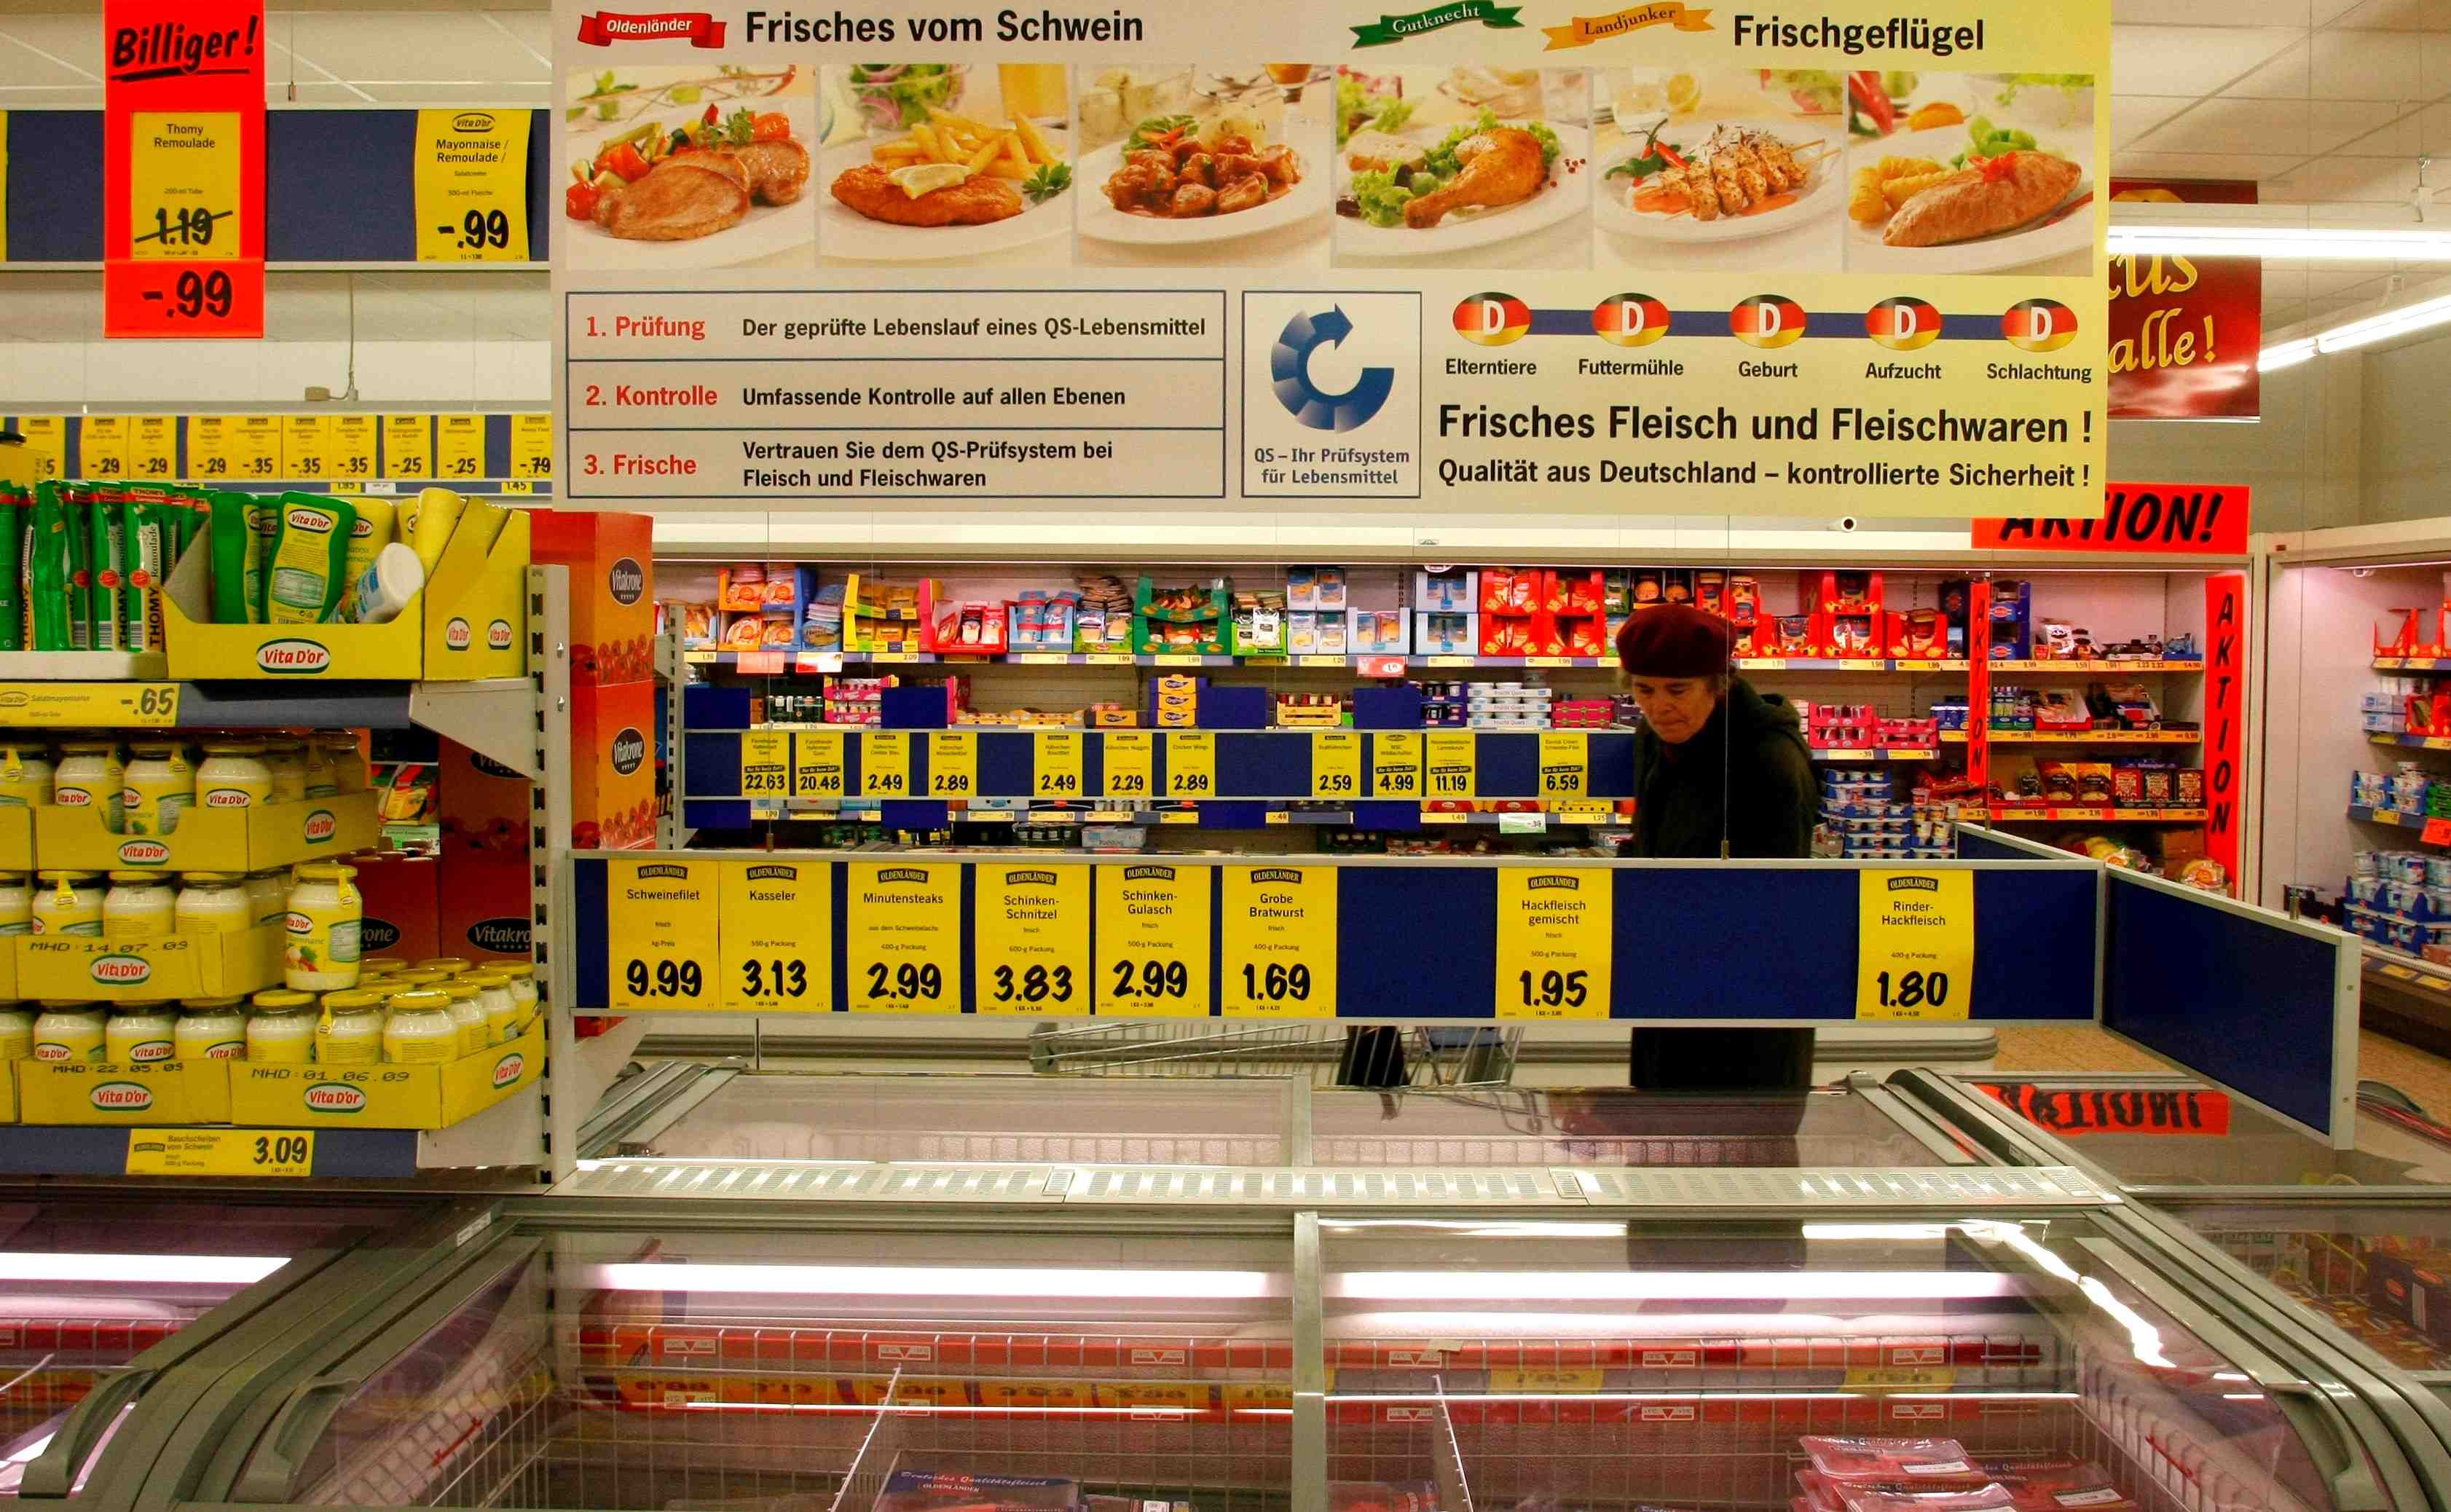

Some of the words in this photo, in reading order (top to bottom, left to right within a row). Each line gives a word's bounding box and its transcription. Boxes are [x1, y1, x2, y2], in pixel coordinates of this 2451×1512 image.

[606, 17, 693, 35] Oldenländer
[745, 12, 894, 43] Frisches
[908, 18, 983, 42] vom
[996, 10, 1144, 42] Schwein
[1392, 5, 1481, 36] Gutknecht
[1584, 7, 1677, 39] Landjunker
[1734, 15, 1986, 58] Frischgeflügel
[167, 123, 204, 135] Thomy
[154, 137, 216, 148] Remoulade
[436, 140, 501, 151] Mayonnaise
[437, 153, 498, 162] Remoulade
[156, 208, 213, 245] 1.19
[438, 210, 509, 249] -.99
[144, 269, 233, 318] -.99
[1482, 299, 1506, 335] D
[1622, 301, 1645, 336] D
[1759, 302, 1781, 337] D
[1895, 305, 1917, 339] D
[2030, 307, 2053, 341] D
[586, 316, 607, 337] 1.
[615, 315, 705, 340] Prüfung
[743, 319, 777, 336] Der
[784, 318, 866, 339] geprüfte
[874, 319, 979, 337] Lebenslauf
[986, 319, 1037, 336] eines
[1044, 318, 1205, 338] QS-Lebensmittel
[1445, 358, 1537, 375] Elterntiere
[1578, 358, 1684, 376] Futtermühle
[1738, 361, 1798, 378] Geburt
[1865, 362, 1941, 380] Aufzucht
[1987, 363, 2092, 384] Schlachtung
[586, 385, 607, 406] 2.
[615, 385, 717, 406] Kontrolle
[743, 387, 861, 406] Umfassende
[868, 387, 955, 406] Kontrolle
[961, 387, 994, 405] auf
[1000, 387, 1046, 405] allen
[1053, 388, 1125, 406] Ebenen
[1439, 403, 1595, 438] Frisches
[1609, 405, 1737, 440] Fleisch
[1752, 407, 1817, 440] und
[1832, 408, 2068, 444] Fleischwaren
[743, 441, 838, 460] Vertrauen
[846, 441, 875, 459] Sie
[882, 441, 924, 459] dem
[932, 441, 1077, 462] QS-Prüfsystem
[1083, 441, 1112, 459] bei
[1254, 449, 1275, 465] QS
[1291, 449, 1315, 463] Ihr
[1321, 448, 1409, 466] Prüfsystem
[583, 454, 605, 475] 3.
[613, 454, 696, 475] Frische
[1439, 458, 1538, 487] Qualität
[1546, 464, 1591, 484] aus
[1600, 460, 1756, 484] Deutschland
[1787, 462, 1940, 486] kontrollierte
[1949, 462, 2075, 487] Sicherheit
[743, 468, 811, 487] Fleisch
[818, 468, 852, 487] und
[859, 468, 986, 488] Fleischwaren
[1262, 469, 1286, 484] für
[1292, 469, 1397, 484] Lebensmittel
[292, 514, 310, 525] Vita
[119, 588, 127, 646] THOMY
[149, 588, 160, 647] THOMY
[264, 650, 293, 664] Vita
[296, 650, 323, 664] D'or
[121, 688, 175, 716] -.65
[613, 739, 643, 763] Vitakrone
[745, 775, 784, 790] 22.63
[800, 776, 840, 790] 20.48
[869, 775, 902, 790] 2.49
[935, 775, 968, 790] 2.89
[1041, 774, 1076, 790] 2.49
[1112, 775, 1144, 790] 2.29
[1174, 774, 1208, 790] 2.89
[1319, 775, 1352, 791] 2.59
[1380, 775, 1414, 791] 4.99
[1436, 775, 1466, 791] 11.19
[1546, 774, 1579, 790] 6.59
[123, 848, 144, 857] Vita
[627, 889, 699, 900] Schweinefilet
[750, 891, 795, 900] Kasseler
[863, 893, 943, 904] Minutensteaks
[1004, 896, 1059, 905] Schinken-
[1122, 891, 1177, 900] Schinken-
[1260, 894, 1293, 904] Grobe
[1007, 909, 1057, 919] Schnitzel
[1128, 905, 1172, 915] Gulasch
[1249, 907, 1305, 918] Bratwurst
[1522, 900, 1586, 910] Hackfleisch
[1894, 901, 1934, 911] Rinder-
[1529, 913, 1579, 926] gemischt
[1882, 915, 1946, 925] Hackfleisch
[475, 926, 531, 942] Vitakro
[97, 964, 119, 977] Vita
[627, 959, 701, 997] 9.99
[741, 959, 807, 996] 3.13
[1112, 960, 1187, 998] 2.99
[867, 962, 942, 999] 2.99
[994, 964, 1073, 1002] 3.83
[1243, 963, 1310, 1001] 1.69
[1519, 970, 1588, 1007] 1.95
[1877, 971, 1948, 1007] 1.80
[98, 1091, 122, 1103] Vita
[310, 1091, 334, 1103] Vita
[337, 1092, 360, 1104] D'or
[253, 1136, 307, 1165] 3.09
